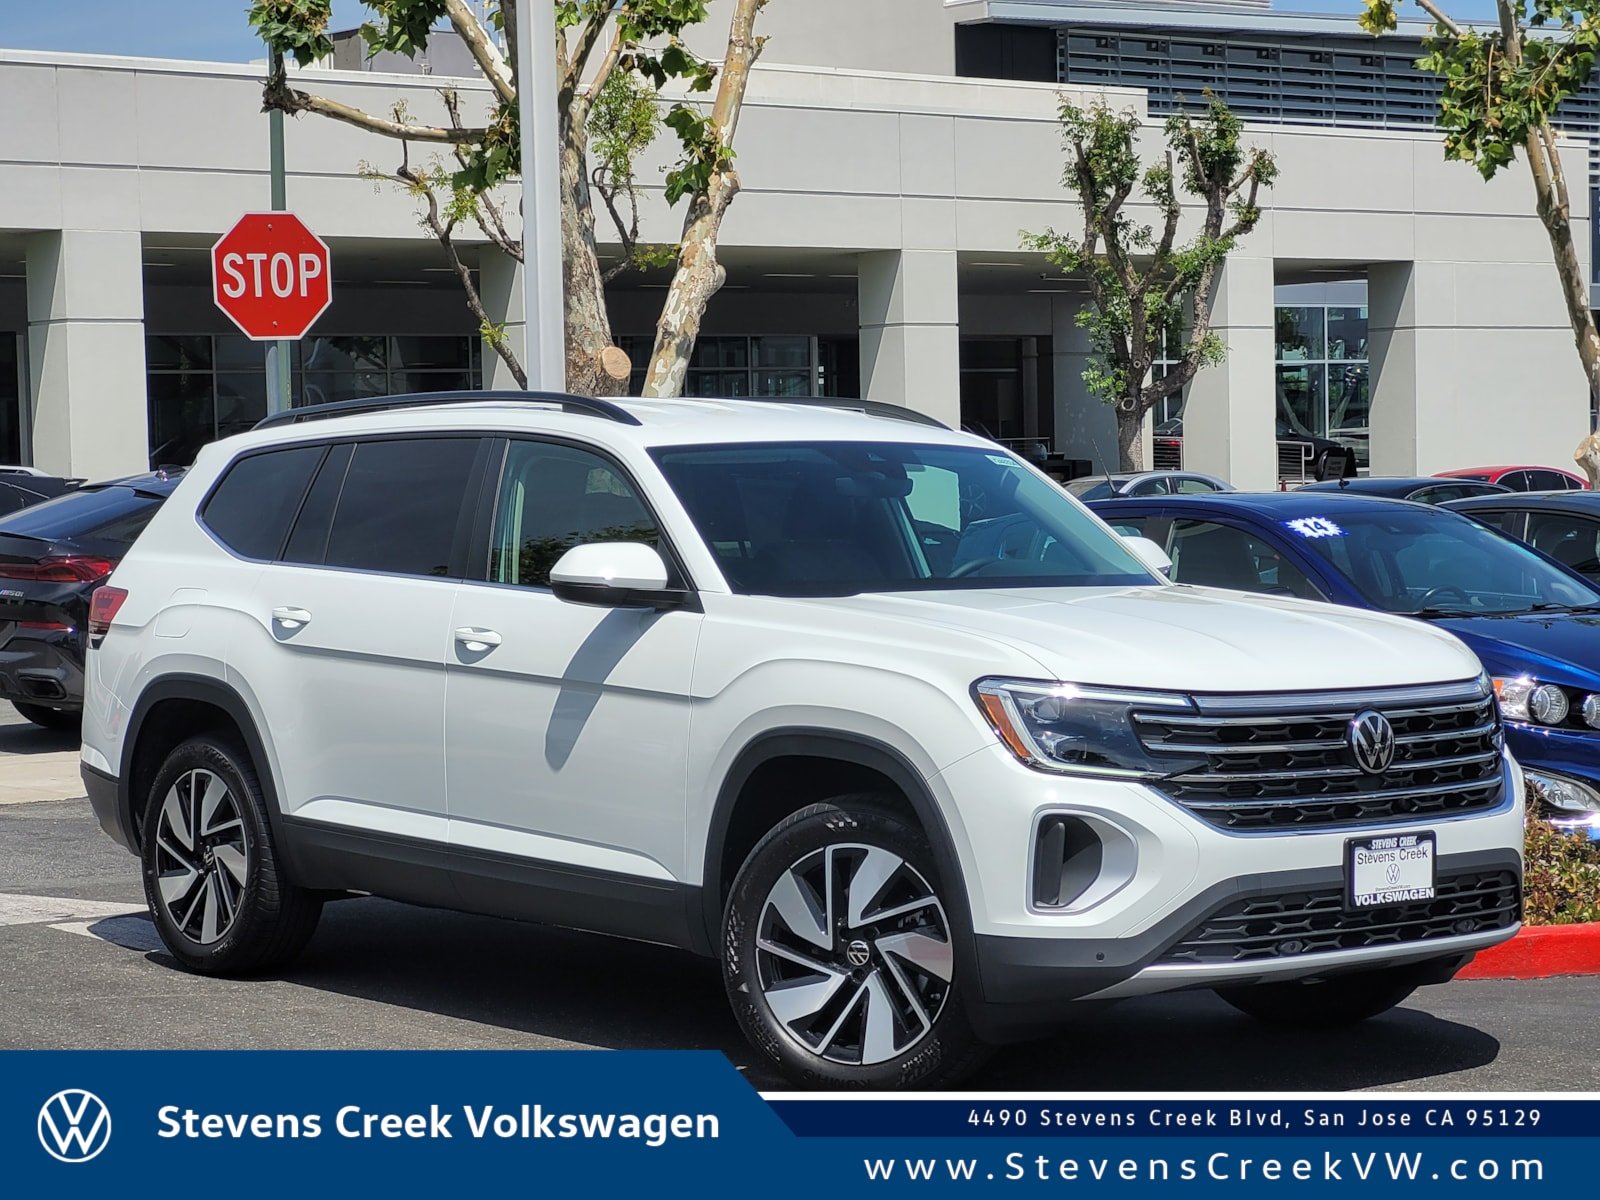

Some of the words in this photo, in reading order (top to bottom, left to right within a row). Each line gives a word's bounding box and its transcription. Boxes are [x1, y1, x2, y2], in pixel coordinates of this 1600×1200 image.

[222, 252, 321, 298] STOP
[1303, 521, 1329, 533] 14
[1371, 838, 1398, 849] STEVENS
[1399, 836, 1418, 847] CREEK
[1357, 852, 1396, 865] Stevens
[1399, 848, 1428, 861] Creek
[1354, 888, 1434, 906] VOLKSWAGEN
